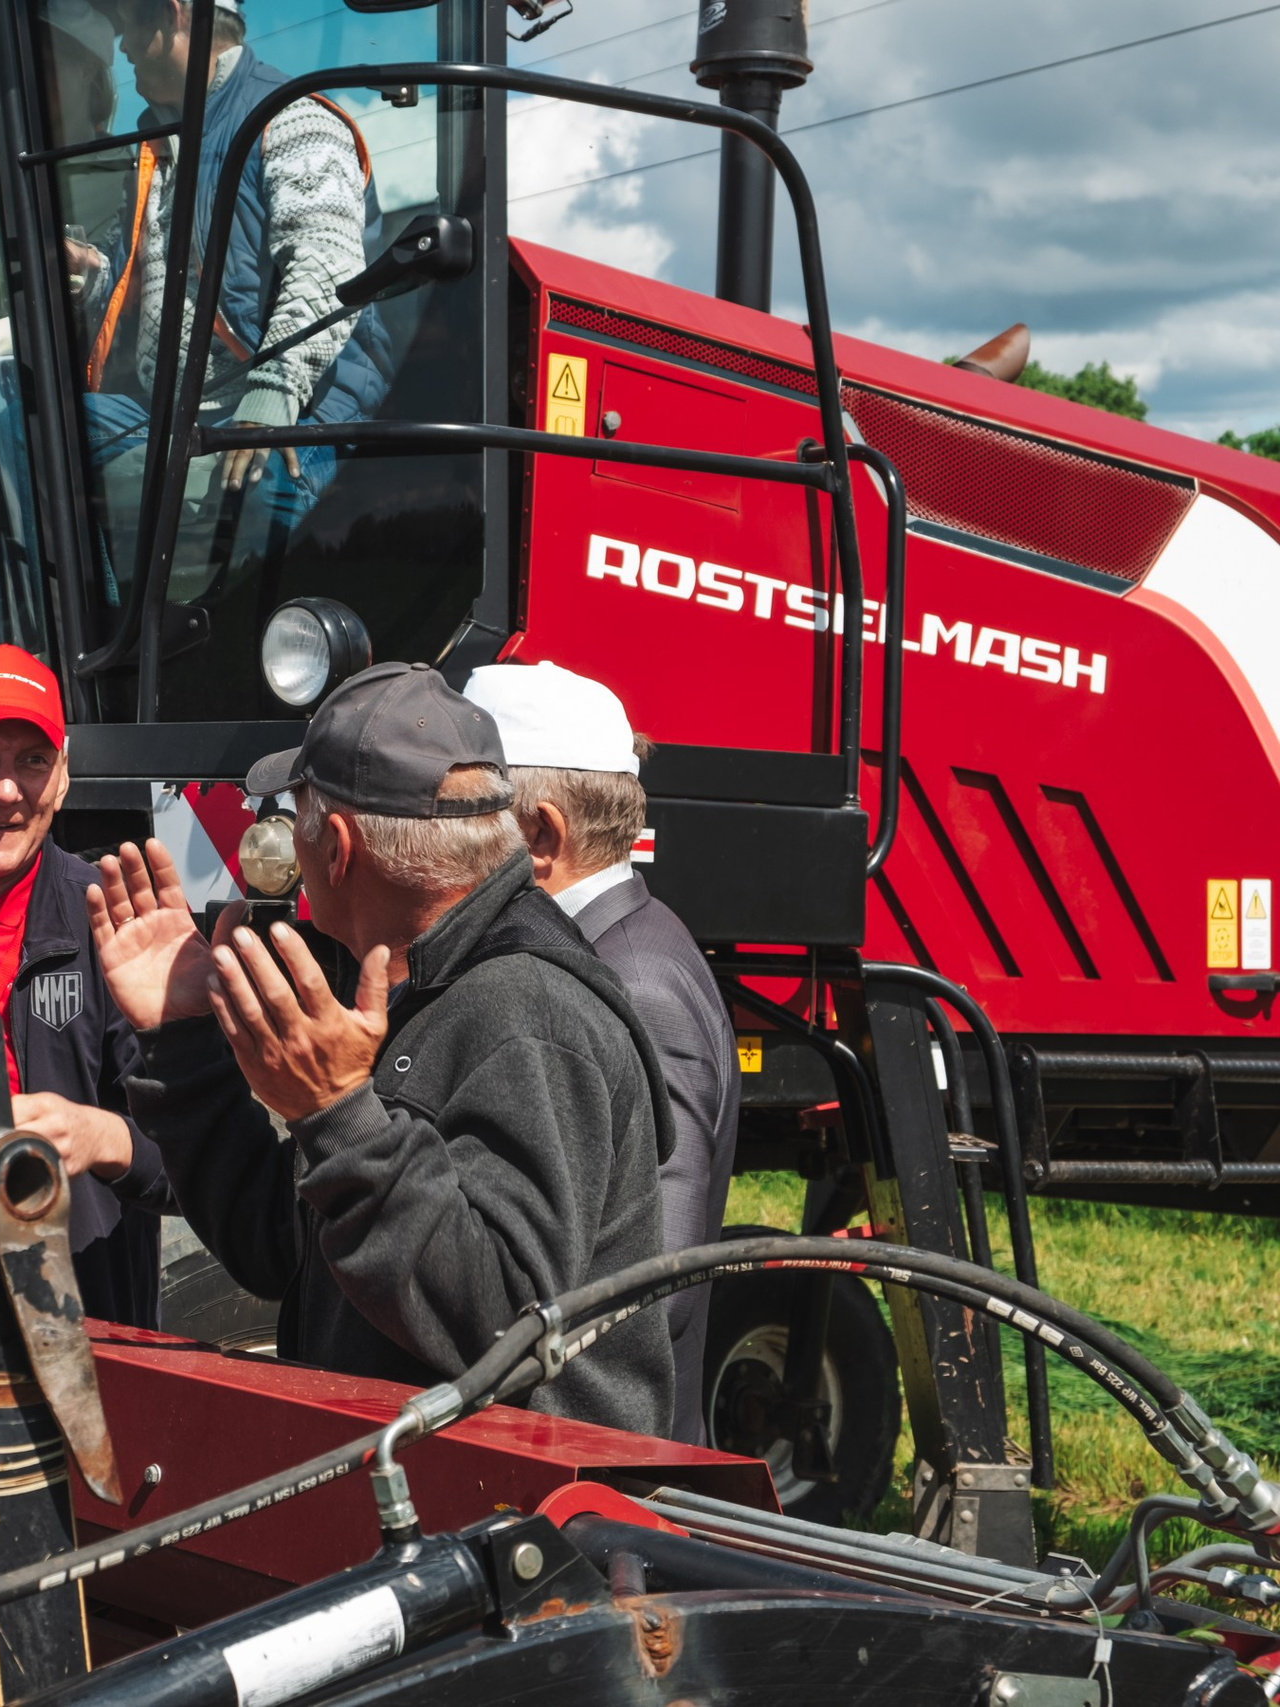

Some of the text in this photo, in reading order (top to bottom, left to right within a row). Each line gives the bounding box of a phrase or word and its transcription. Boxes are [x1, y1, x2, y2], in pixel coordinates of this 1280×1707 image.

[34, 974, 80, 1026] MMA
[1089, 1359, 1108, 1376] Bar
[1106, 1371, 1125, 1390] 225
[1122, 1388, 1139, 1404] WP
